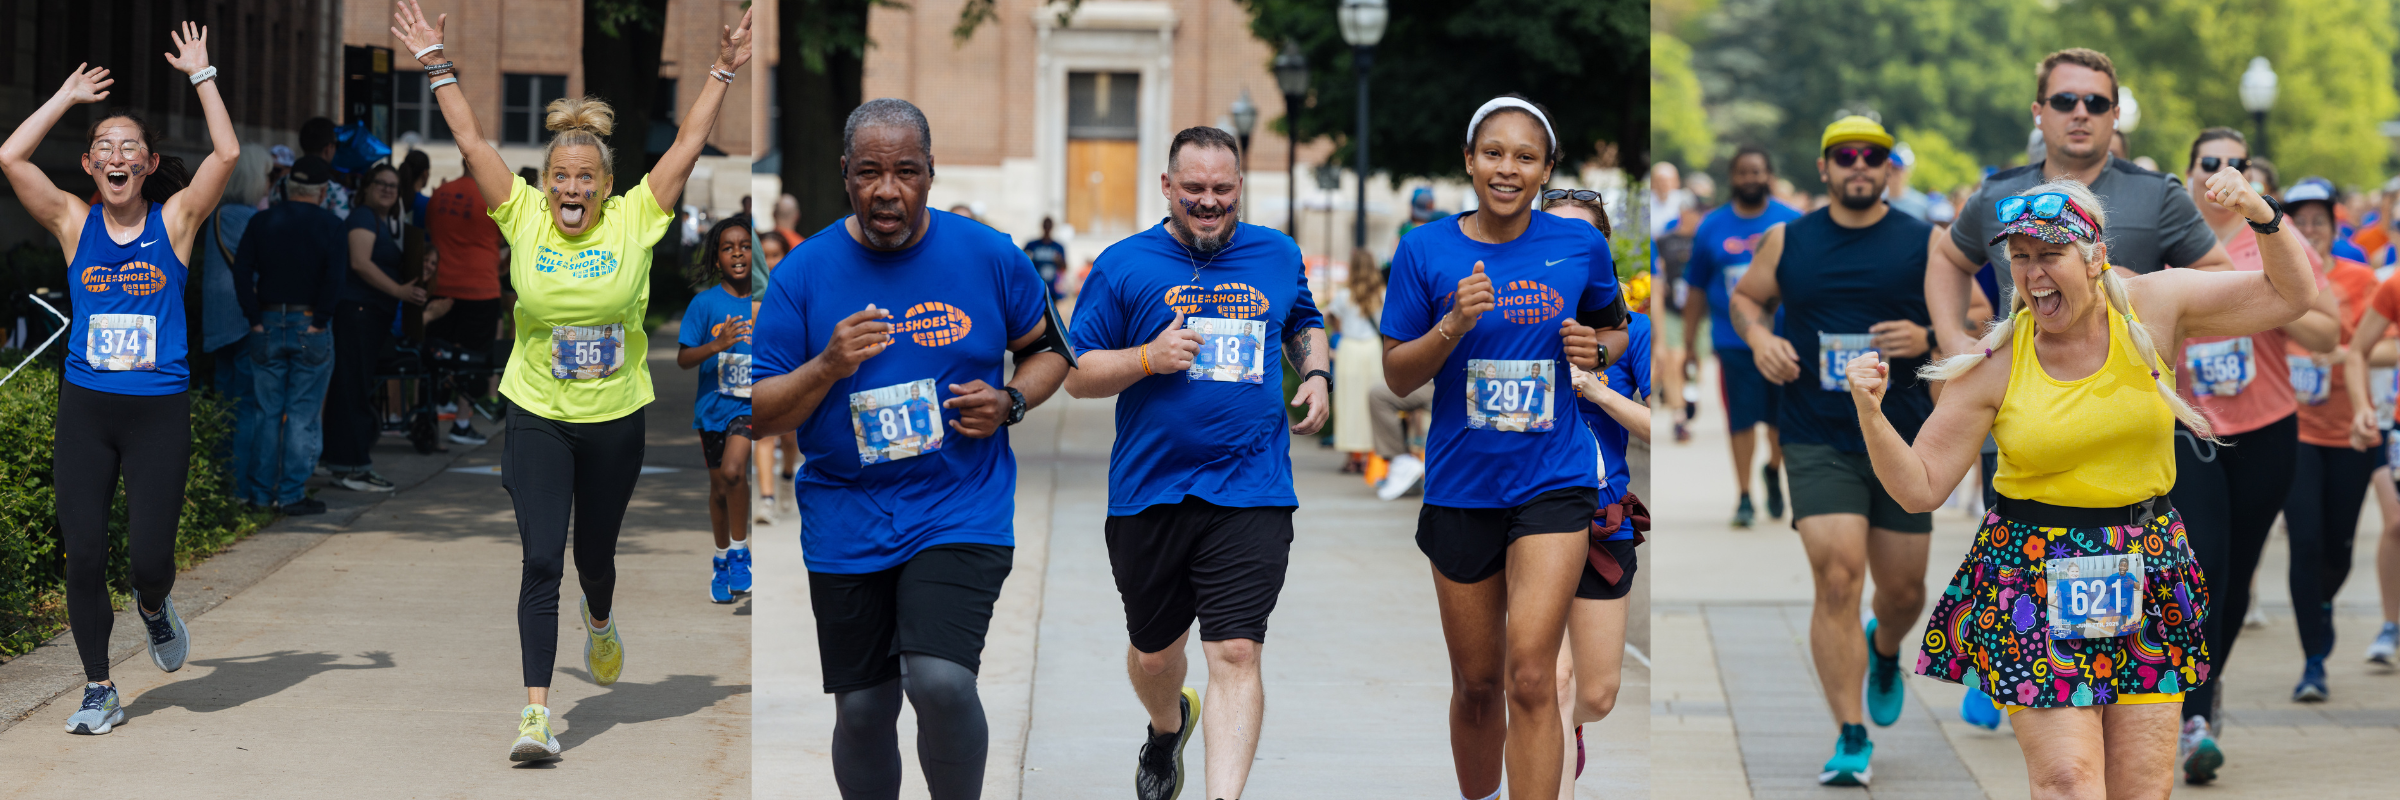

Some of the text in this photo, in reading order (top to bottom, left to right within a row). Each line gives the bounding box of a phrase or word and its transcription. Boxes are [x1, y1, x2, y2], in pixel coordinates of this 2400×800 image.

[538, 254, 564, 266] MILE
[568, 257, 601, 271] SHOES
[90, 274, 112, 284] MILE
[118, 272, 150, 283] SHOES
[1177, 293, 1204, 304] MILE
[1212, 293, 1249, 304] SHOES
[1497, 294, 1540, 308] SHOES
[905, 315, 947, 332] SHOES
[101, 329, 140, 355] 374
[1215, 336, 1241, 364] 13
[575, 341, 601, 365] 55
[2201, 353, 2241, 383] 558
[1486, 379, 1536, 412] 297
[878, 404, 913, 440] 81
[2076, 578, 2127, 616] 621
